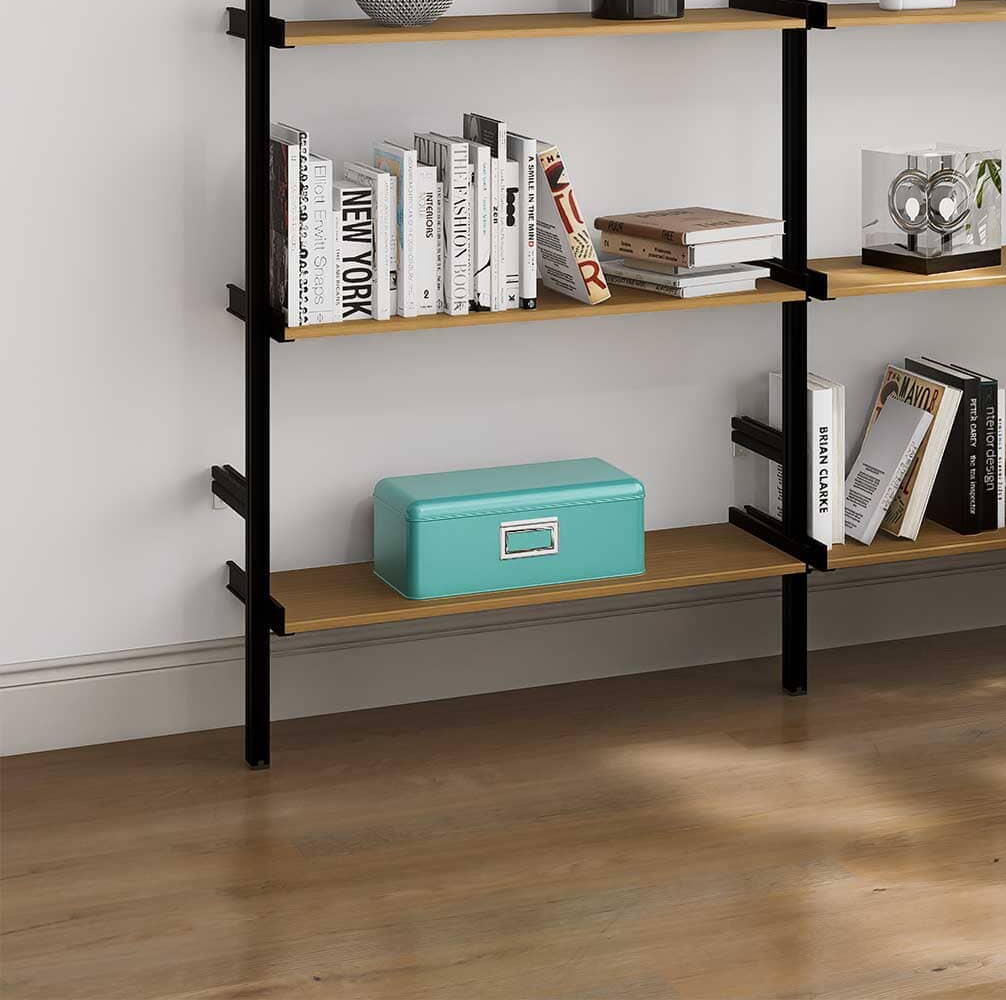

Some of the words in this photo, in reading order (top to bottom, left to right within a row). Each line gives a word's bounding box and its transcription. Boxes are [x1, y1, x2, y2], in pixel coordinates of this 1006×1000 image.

[314, 165, 327, 204] Elliott
[453, 145, 467, 182] THE
[342, 190, 372, 243] NEW
[528, 193, 534, 203] IN
[314, 209, 327, 251] Erwitt
[453, 186, 467, 259] FASHION
[311, 255, 327, 305] Snaps
[342, 251, 372, 318] YORK
[424, 289, 430, 299] 2
[453, 262, 467, 311] BOOK
[969, 398, 977, 421] PETER
[819, 426, 829, 465] BRIAN
[819, 467, 829, 514] CLARKE
